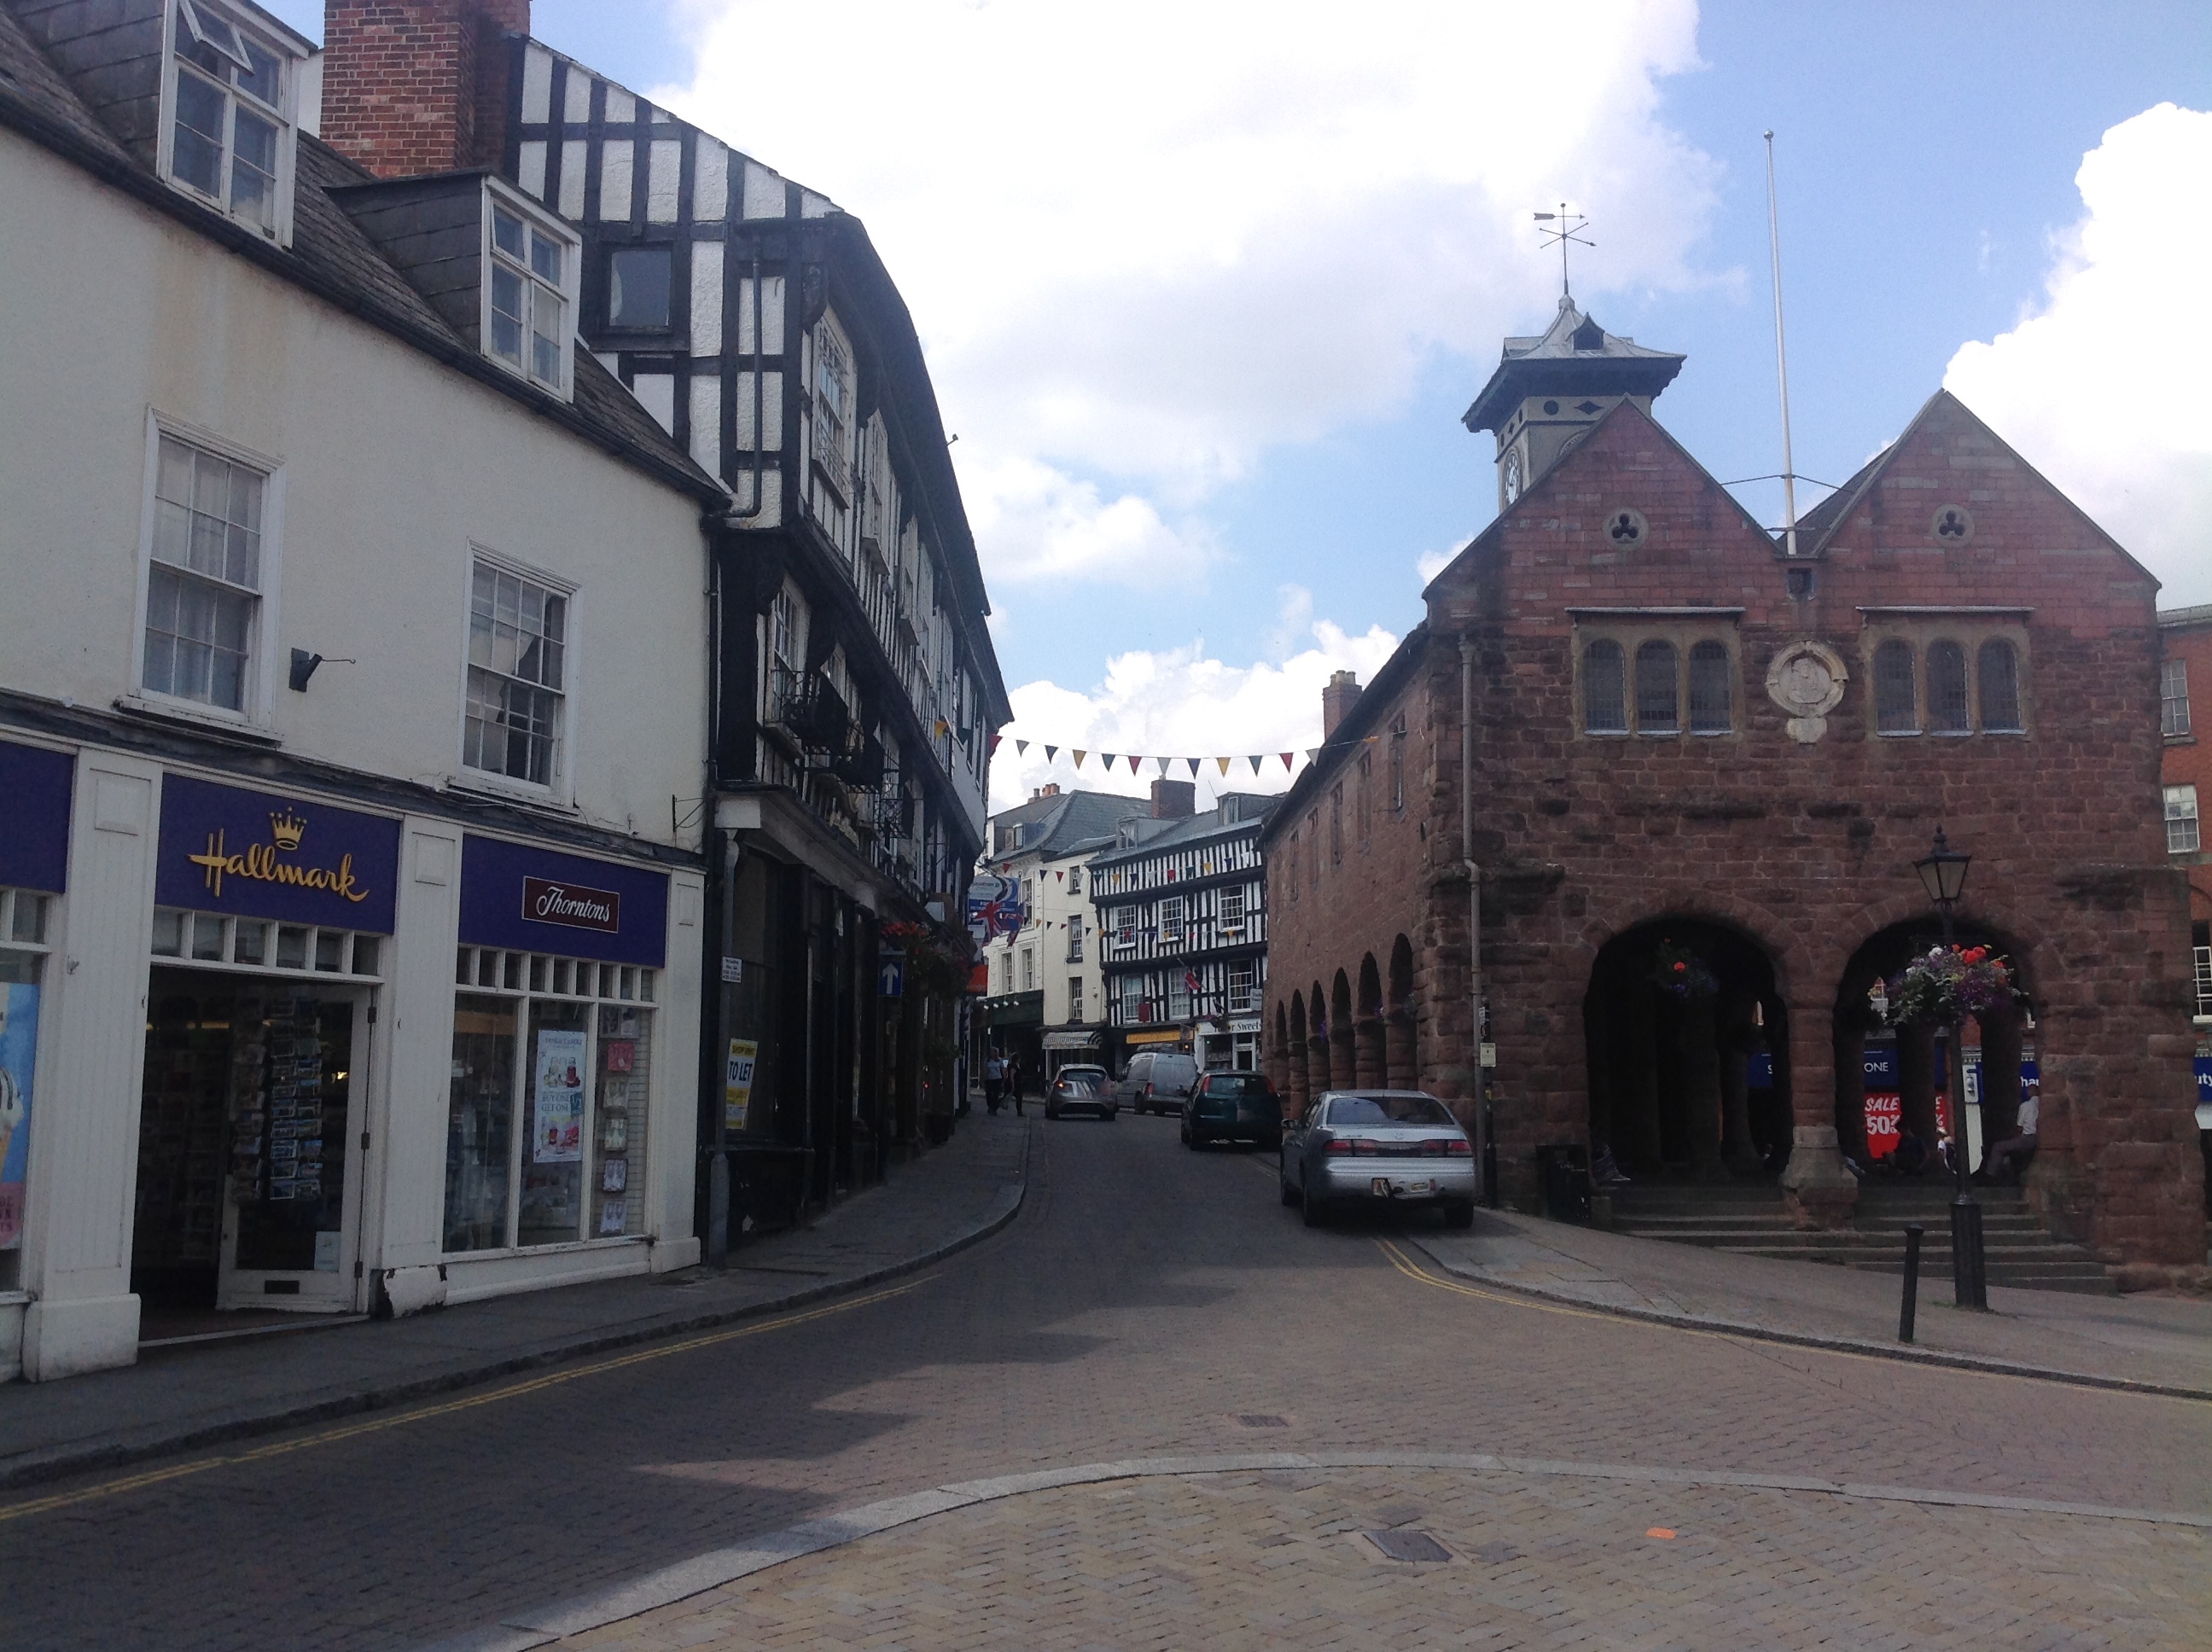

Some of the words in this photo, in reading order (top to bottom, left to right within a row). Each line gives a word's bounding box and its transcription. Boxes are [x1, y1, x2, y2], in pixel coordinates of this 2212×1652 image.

[187, 828, 370, 902] Hallmark
[536, 886, 610, 922] Thorntons
[1237, 1021, 1262, 1031] Sweets
[729, 1061, 739, 1080] TO
[739, 1062, 753, 1081] LET
[1864, 1062, 1889, 1073] ONE
[1865, 1096, 1901, 1112] SALE
[1866, 1114, 1901, 1135] 50%
